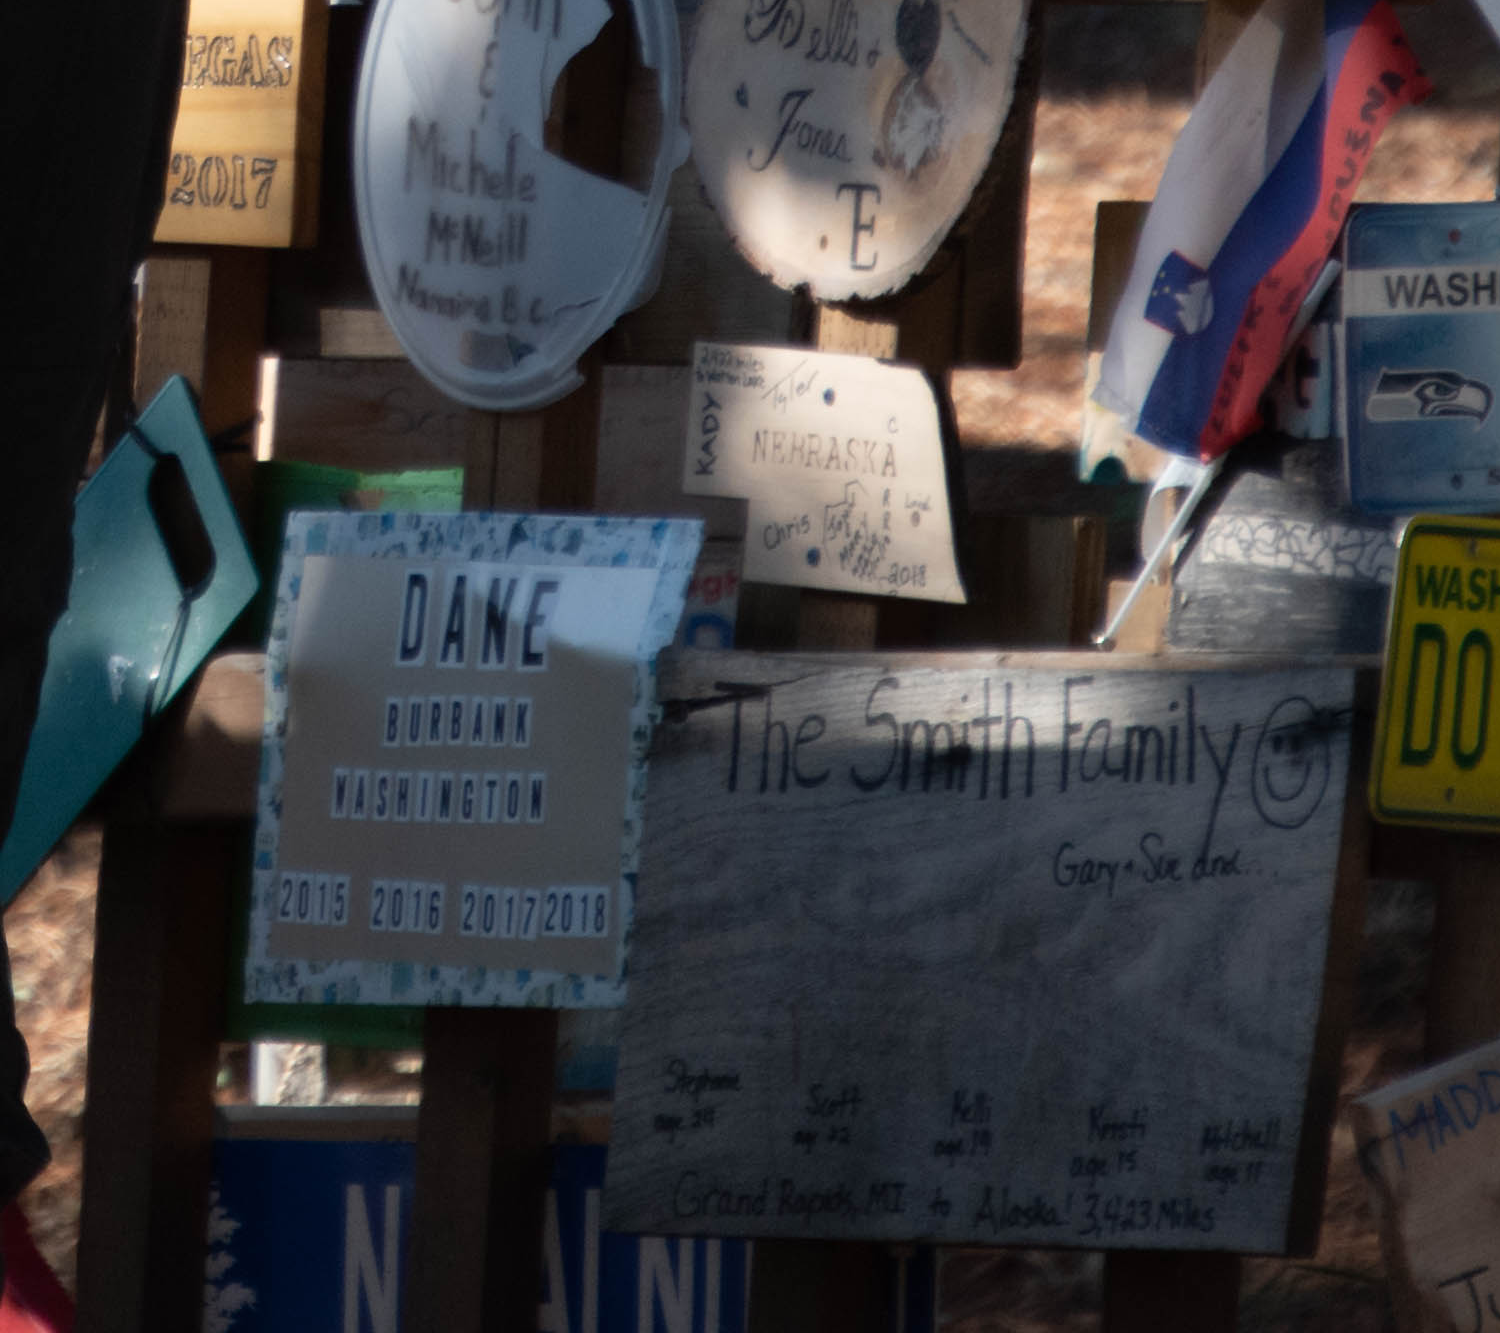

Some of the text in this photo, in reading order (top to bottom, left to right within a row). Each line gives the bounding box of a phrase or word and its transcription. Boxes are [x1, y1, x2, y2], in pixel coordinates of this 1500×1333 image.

[169, 153, 279, 210] 2017
[395, 567, 560, 671] DANE
[382, 697, 533, 747] BURBANK
[713, 675, 1243, 854] The Smith Family
[330, 769, 547, 824] WASHINGTON
[277, 875, 610, 940] 2015 2016 2017 2018
[671, 1169, 771, 1220] Grand
